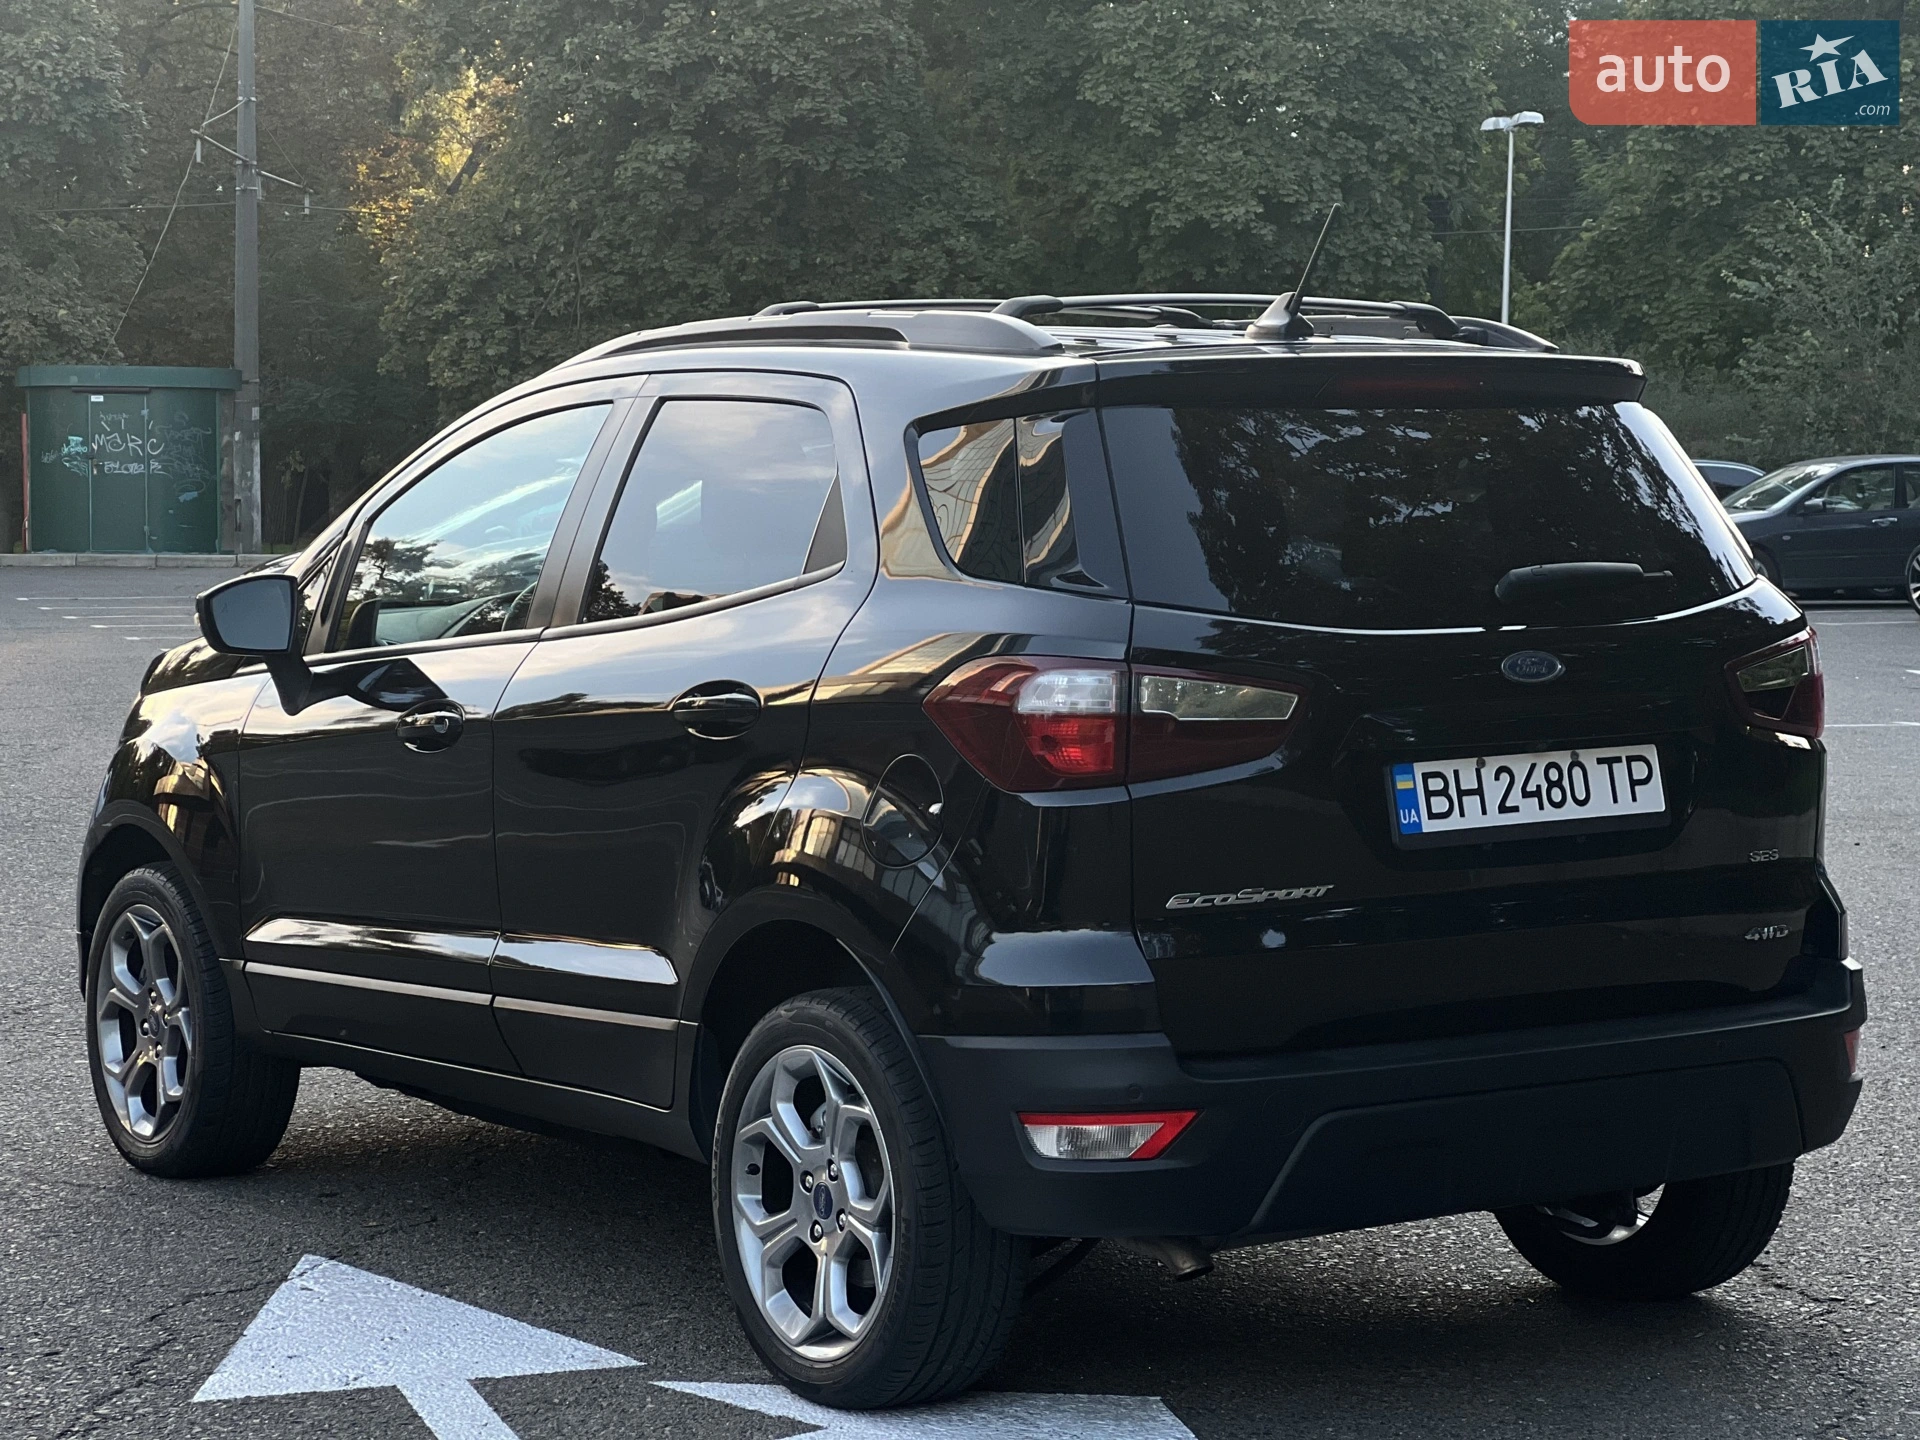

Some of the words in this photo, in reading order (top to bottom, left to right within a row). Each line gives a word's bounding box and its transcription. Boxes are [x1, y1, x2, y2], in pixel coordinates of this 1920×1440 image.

[1421, 766, 1488, 821] BH
[1493, 759, 1592, 815] 2480
[1596, 754, 1654, 804] TP
[1400, 808, 1419, 825] UA
